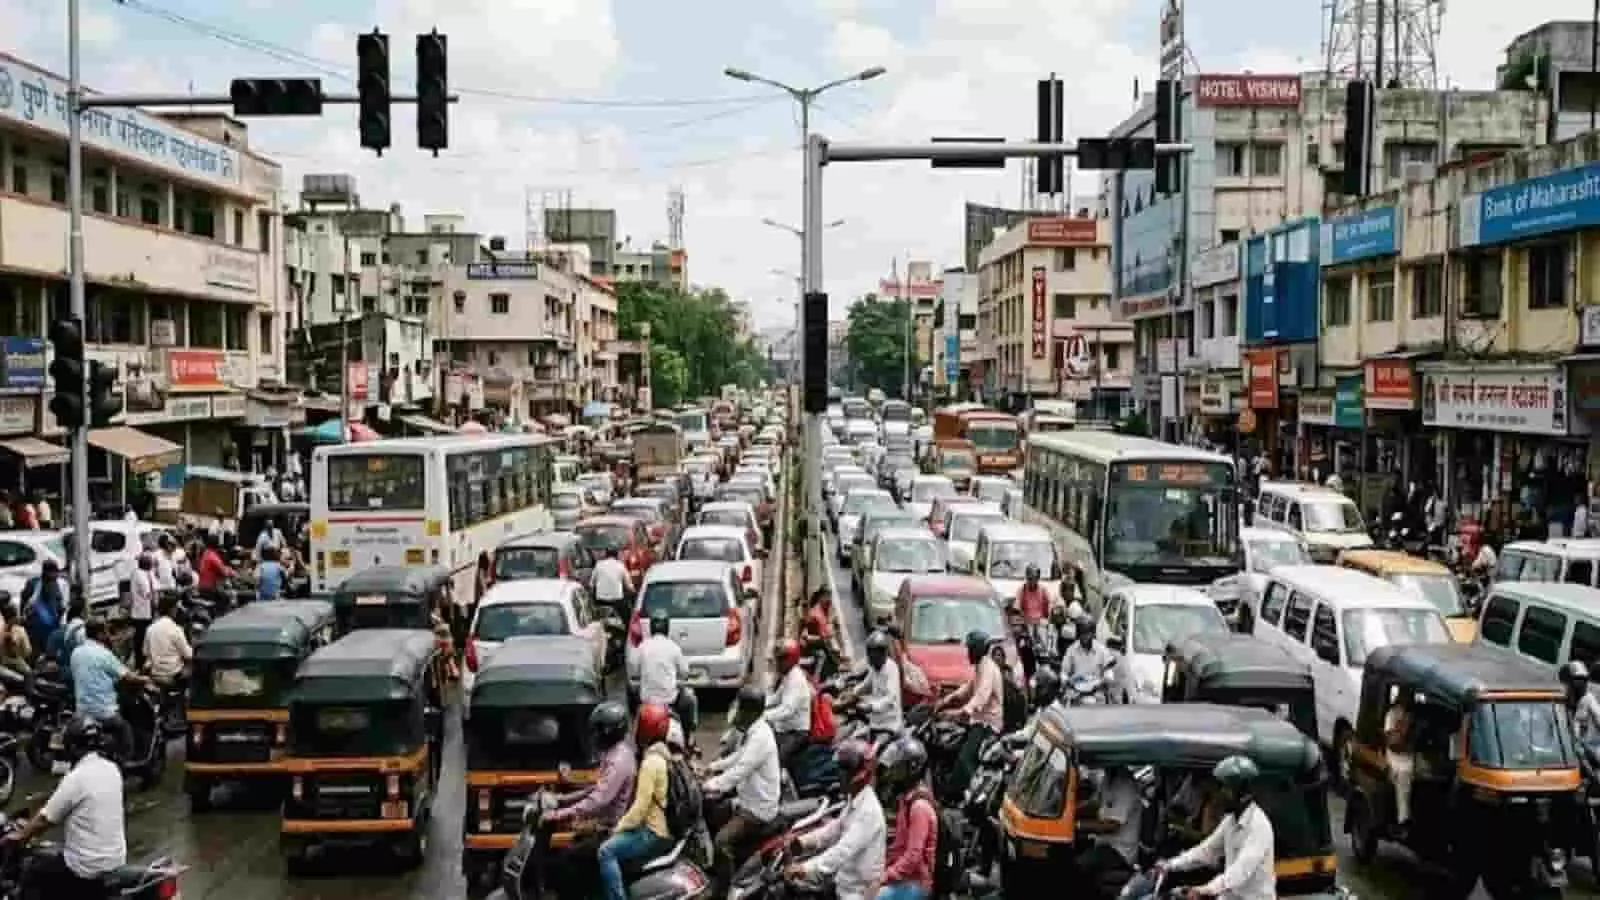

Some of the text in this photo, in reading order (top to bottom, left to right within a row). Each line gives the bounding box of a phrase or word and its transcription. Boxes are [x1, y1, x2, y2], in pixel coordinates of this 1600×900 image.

[20, 77, 48, 120] पुणे
[1200, 79, 1298, 98] HOTEL VISHWA
[1485, 193, 1513, 220] Bank
[1515, 185, 1529, 214] of
